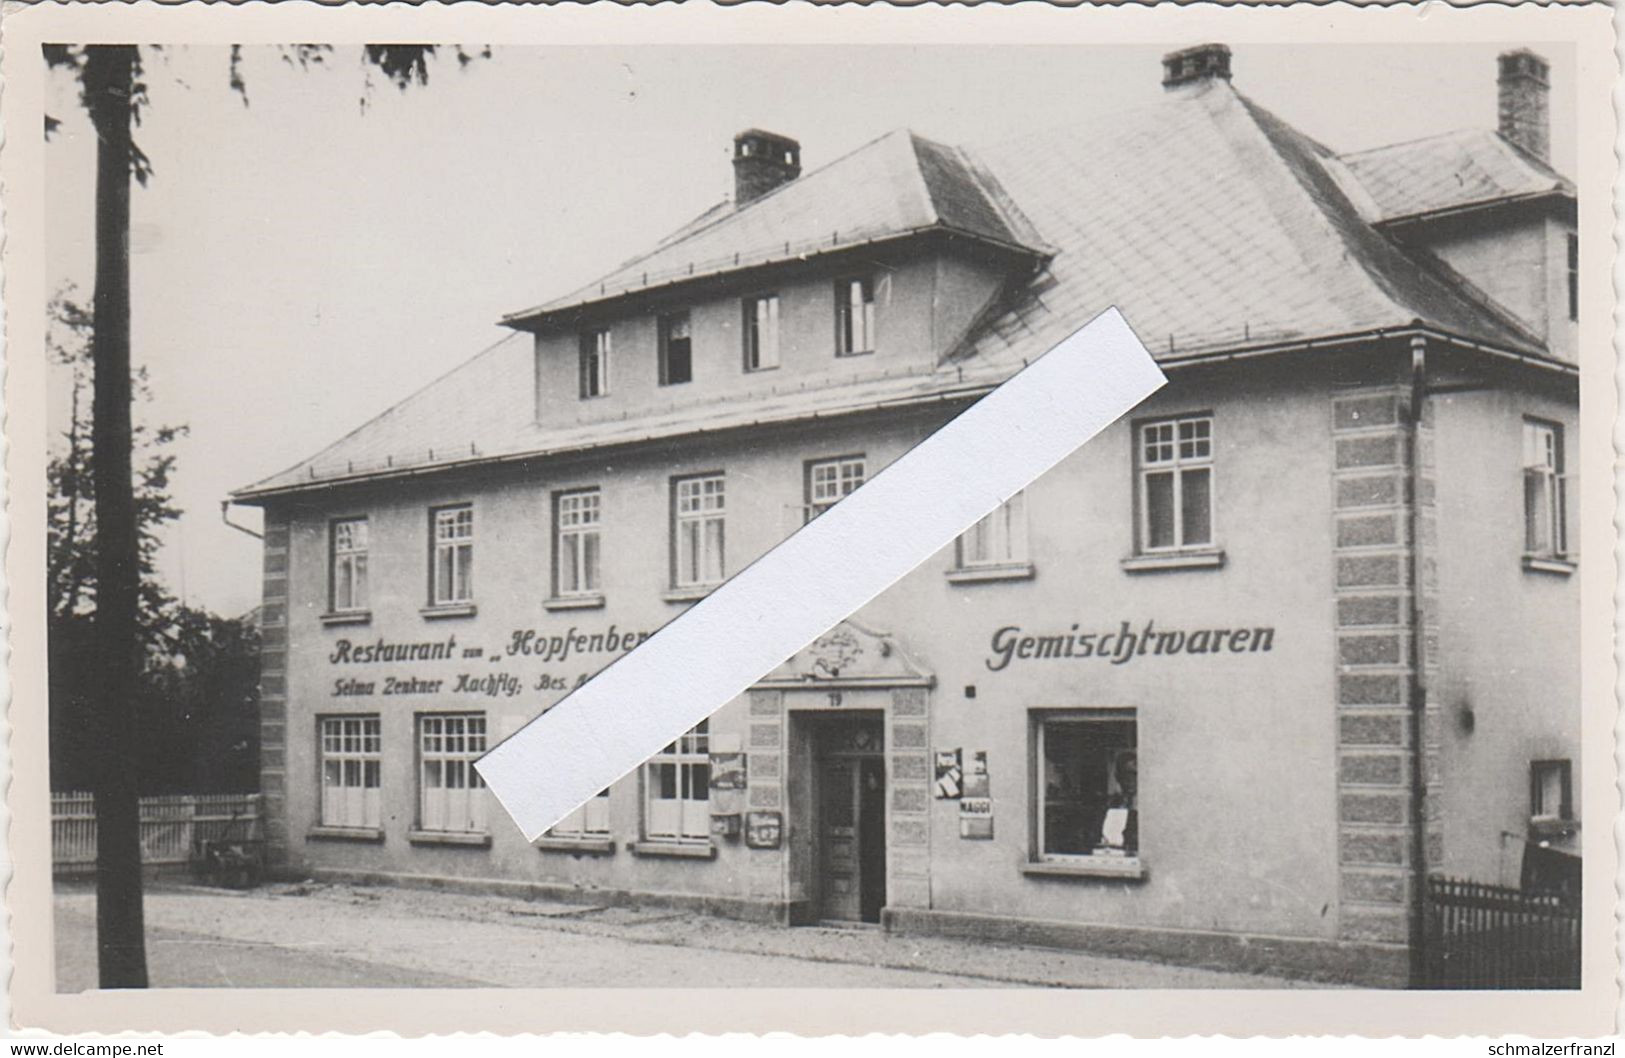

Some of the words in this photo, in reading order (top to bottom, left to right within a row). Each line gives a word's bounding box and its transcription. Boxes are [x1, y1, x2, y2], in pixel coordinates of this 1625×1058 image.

[329, 634, 456, 664] Restaurant
[985, 619, 1276, 672] Gemischtwaren
[331, 677, 375, 697] Selma
